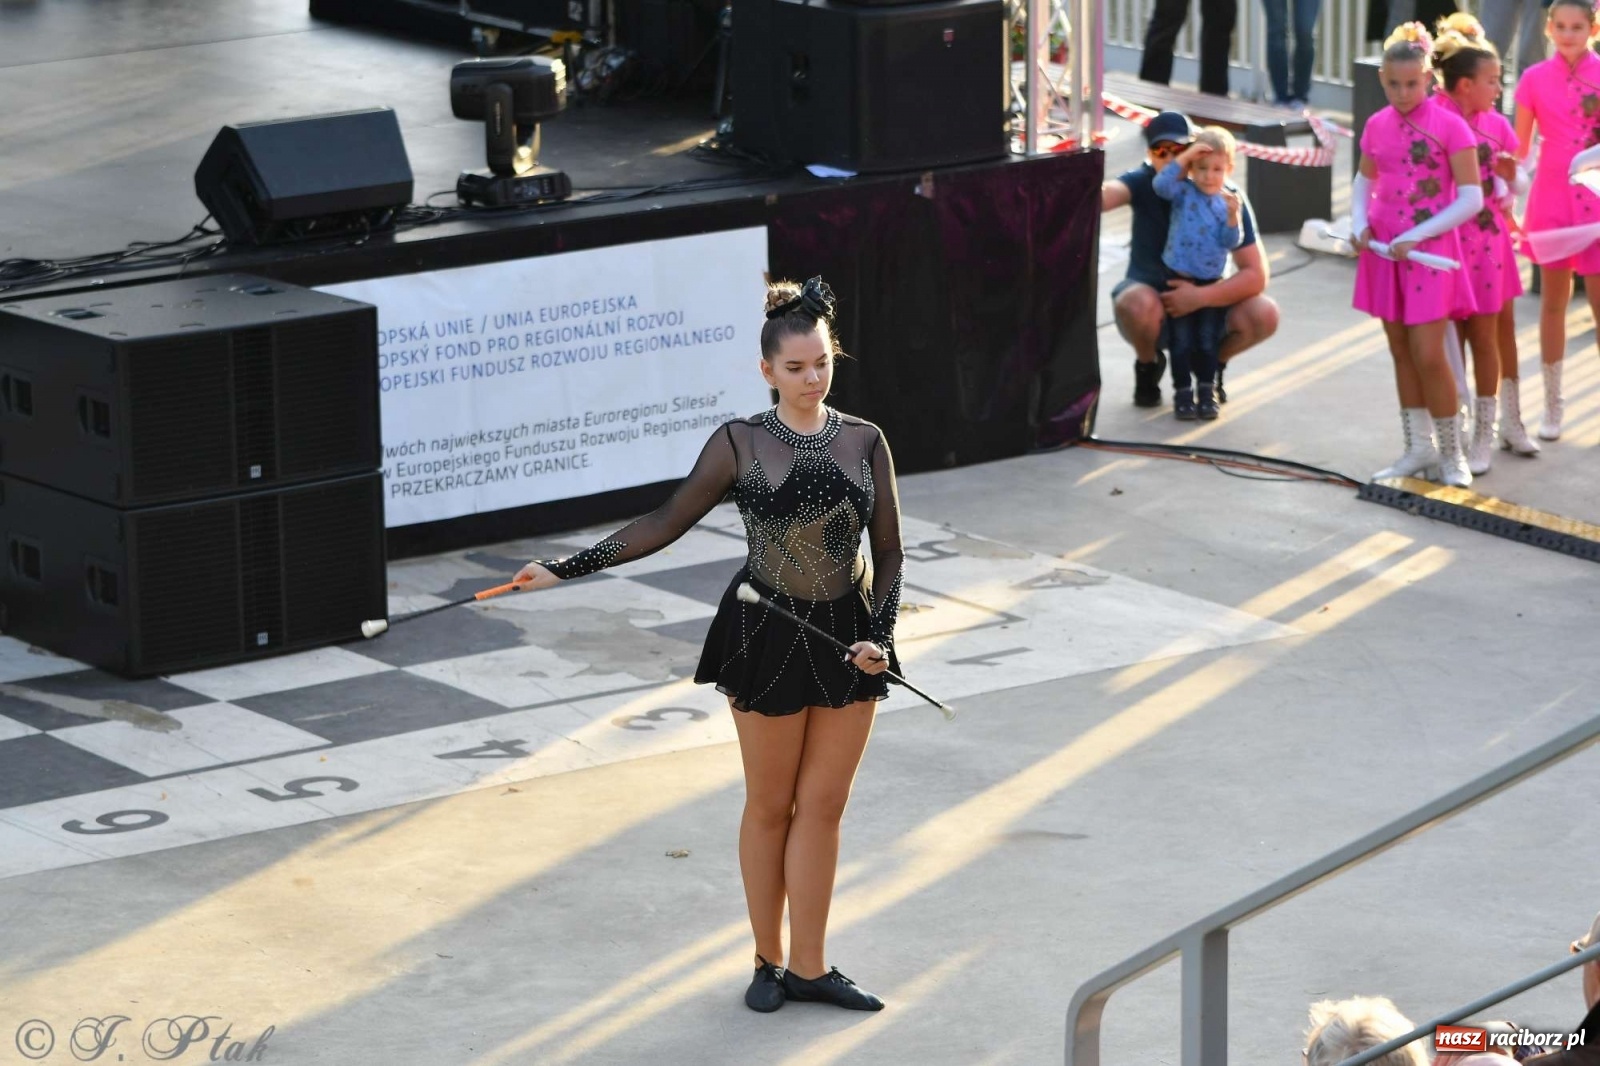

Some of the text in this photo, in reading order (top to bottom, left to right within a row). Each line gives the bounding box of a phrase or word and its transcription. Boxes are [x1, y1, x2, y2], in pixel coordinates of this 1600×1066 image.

[435, 318, 475, 338] UNIE
[481, 314, 488, 334] /
[494, 310, 535, 330] UNIA
[540, 294, 638, 323] EUROPEJSKA
[436, 340, 482, 361] FOND
[488, 334, 520, 353] PRO
[525, 315, 622, 348] REGIONÁLNÍ
[627, 310, 684, 333] ROZVOJ
[380, 324, 736, 393] OPEJSKI FUNDUSZ ROZWOJU REGIONALNEGO
[396, 449, 501, 478] Europejskiego
[504, 437, 576, 460] Funduszu
[580, 422, 639, 448] Rozwoju
[431, 423, 530, 453] największych
[532, 415, 580, 436] miasta
[584, 402, 668, 428] Euroregionu
[390, 452, 594, 499] PRZEKRACZAMY GRANICE.
[247, 775, 361, 802] 5
